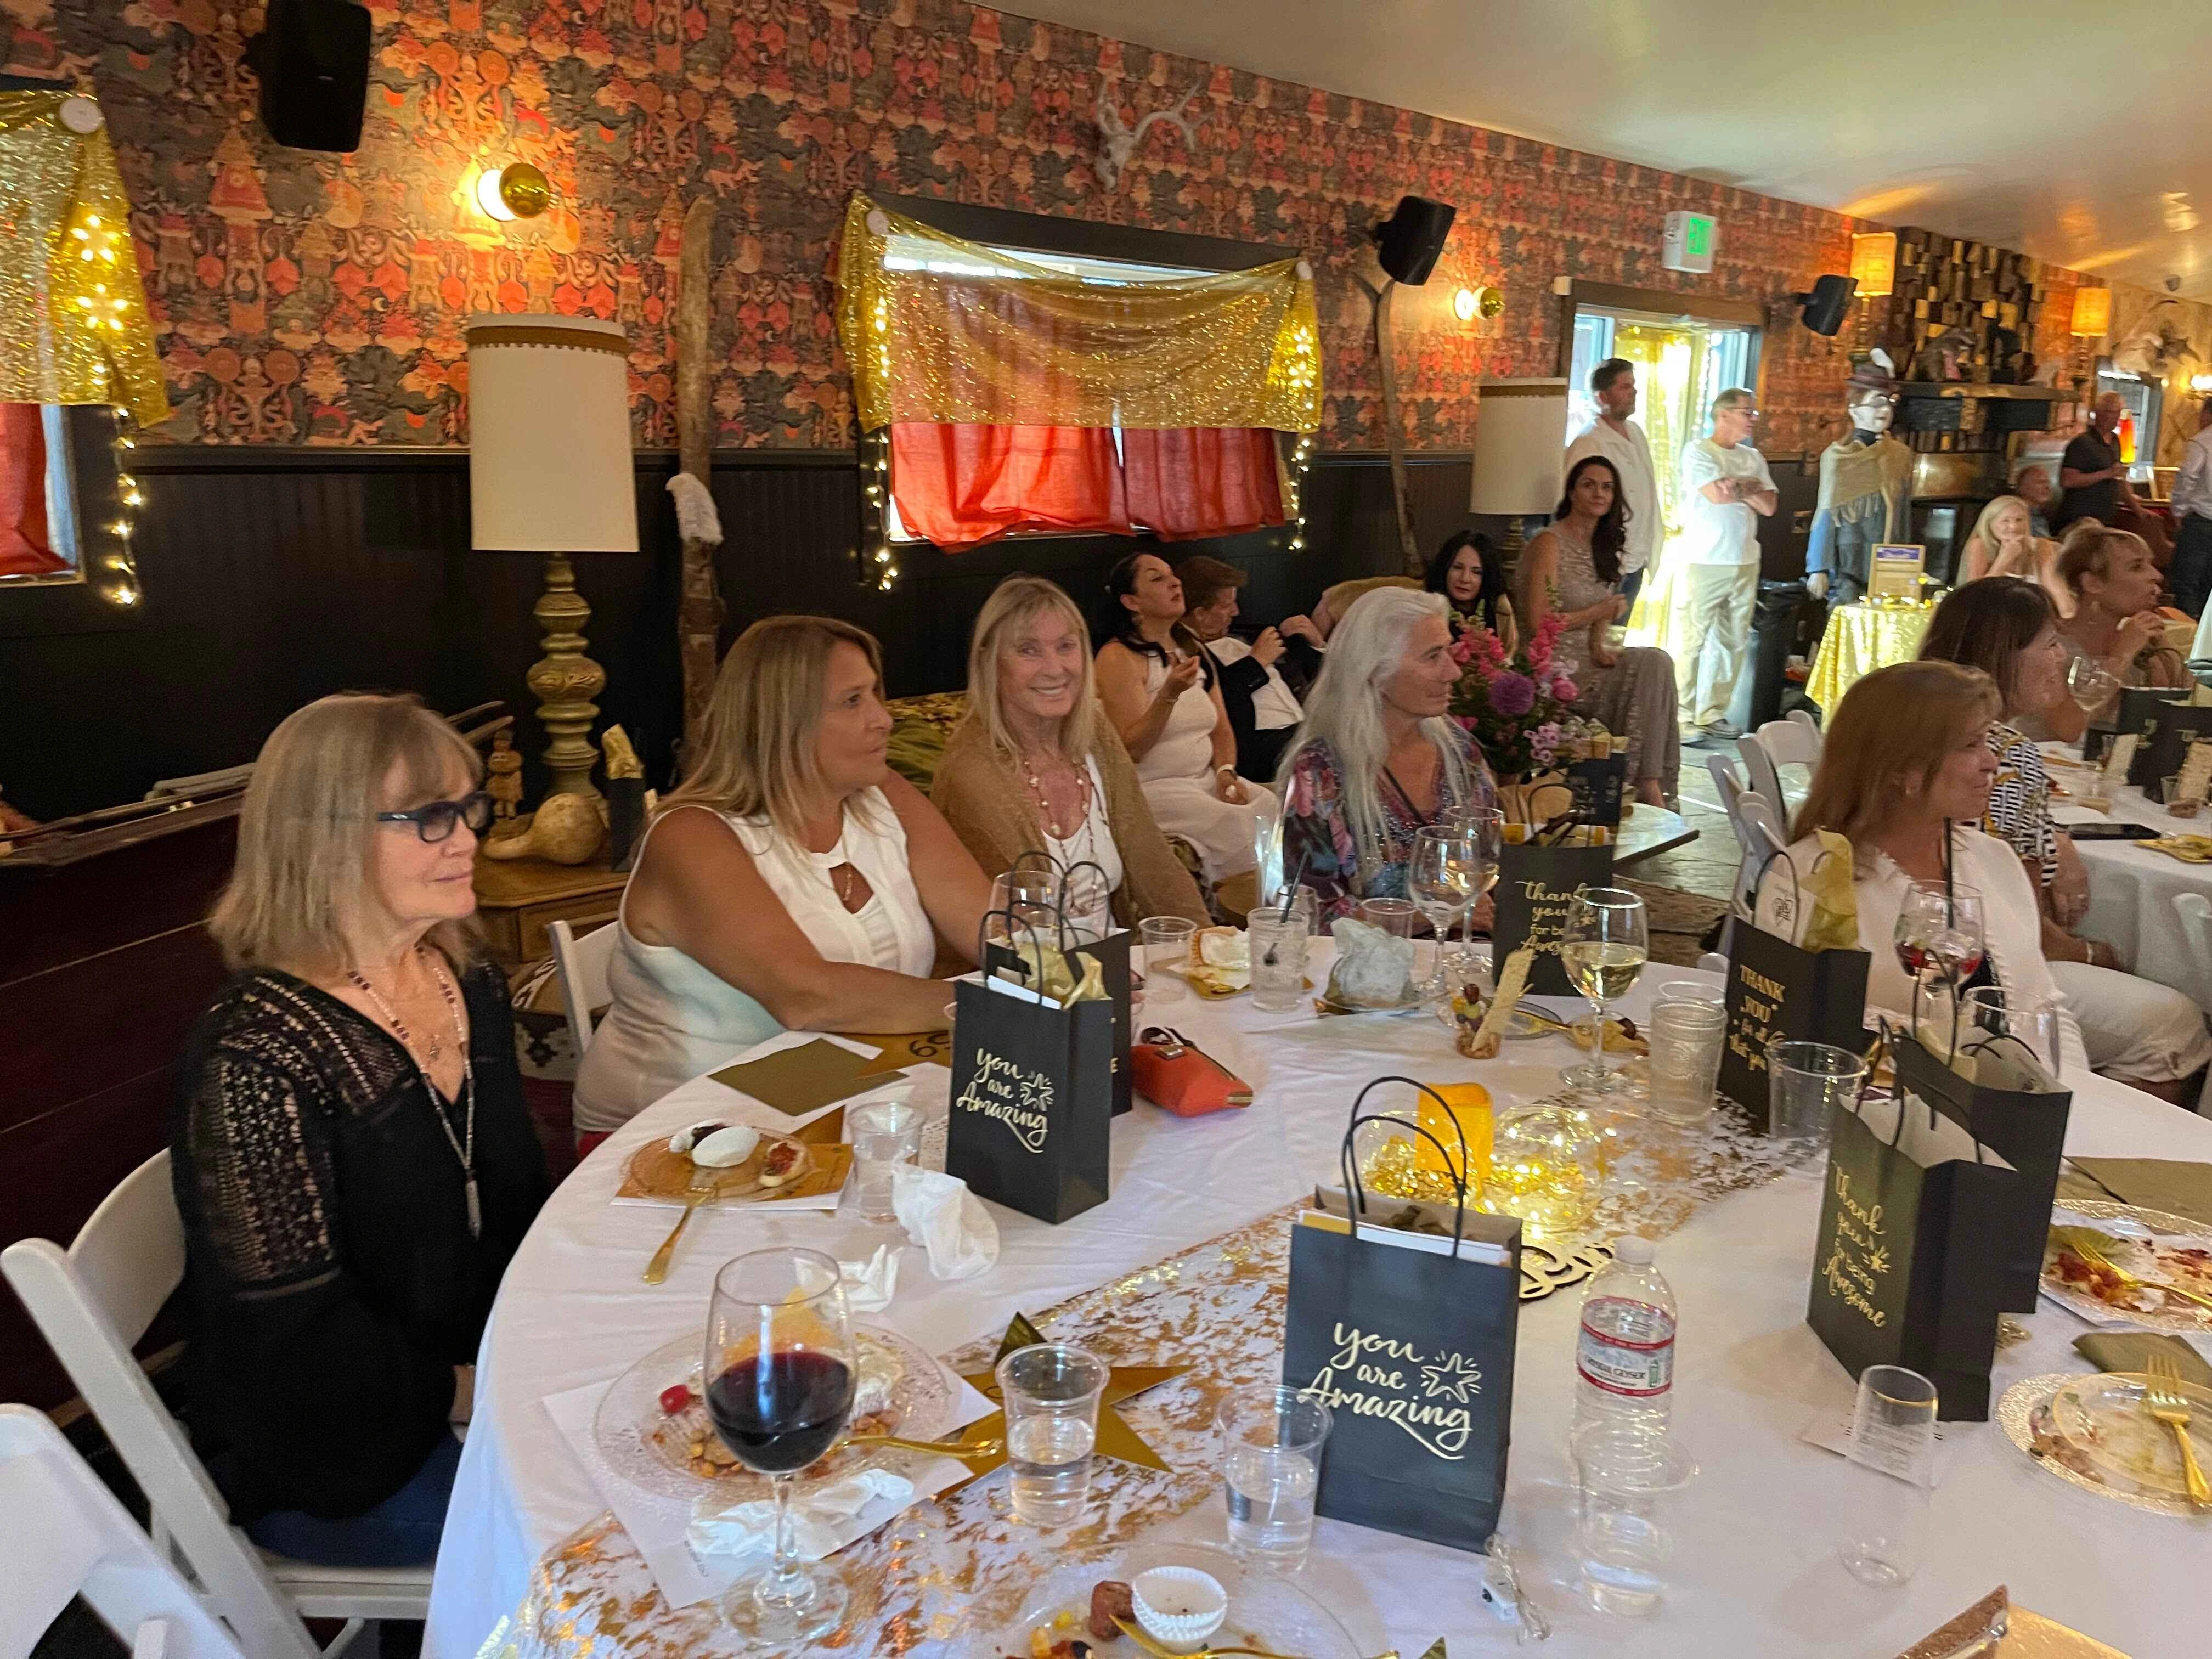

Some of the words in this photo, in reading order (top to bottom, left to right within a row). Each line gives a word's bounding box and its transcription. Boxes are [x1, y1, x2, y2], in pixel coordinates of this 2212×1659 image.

[1739, 964, 1786, 1003] THANK
[974, 1047, 1023, 1084] you
[987, 1079, 1015, 1100] are
[956, 1080, 1049, 1154] Amazing
[1330, 1322, 1425, 1371] you
[1357, 1364, 1407, 1390] are
[1296, 1366, 1474, 1460] Amazing
